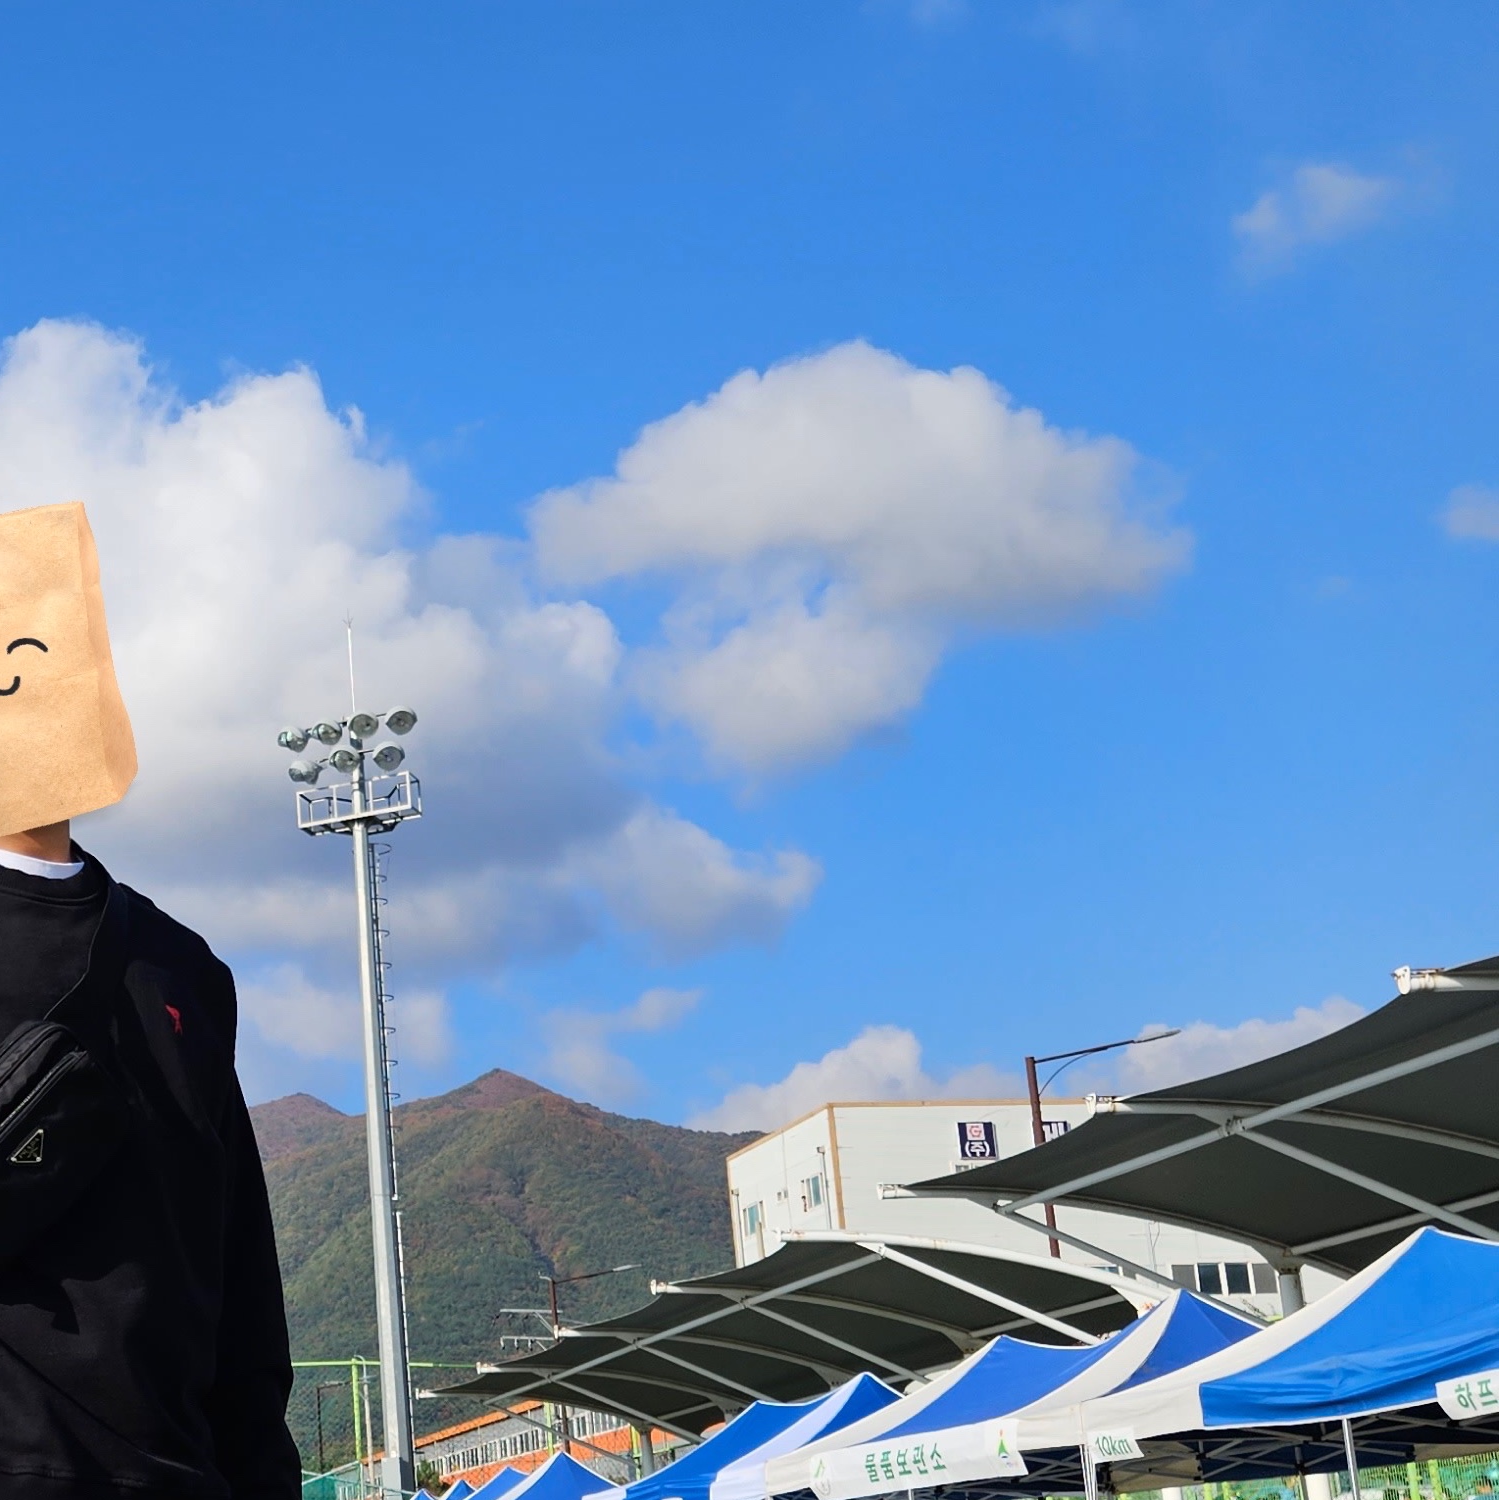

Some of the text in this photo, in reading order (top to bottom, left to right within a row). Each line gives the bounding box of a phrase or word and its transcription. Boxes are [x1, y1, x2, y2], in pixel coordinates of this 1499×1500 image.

[964, 1140, 991, 1157] (주)
[1095, 1435, 1133, 1457] 10km
[865, 1443, 947, 1483] 물품보관소
